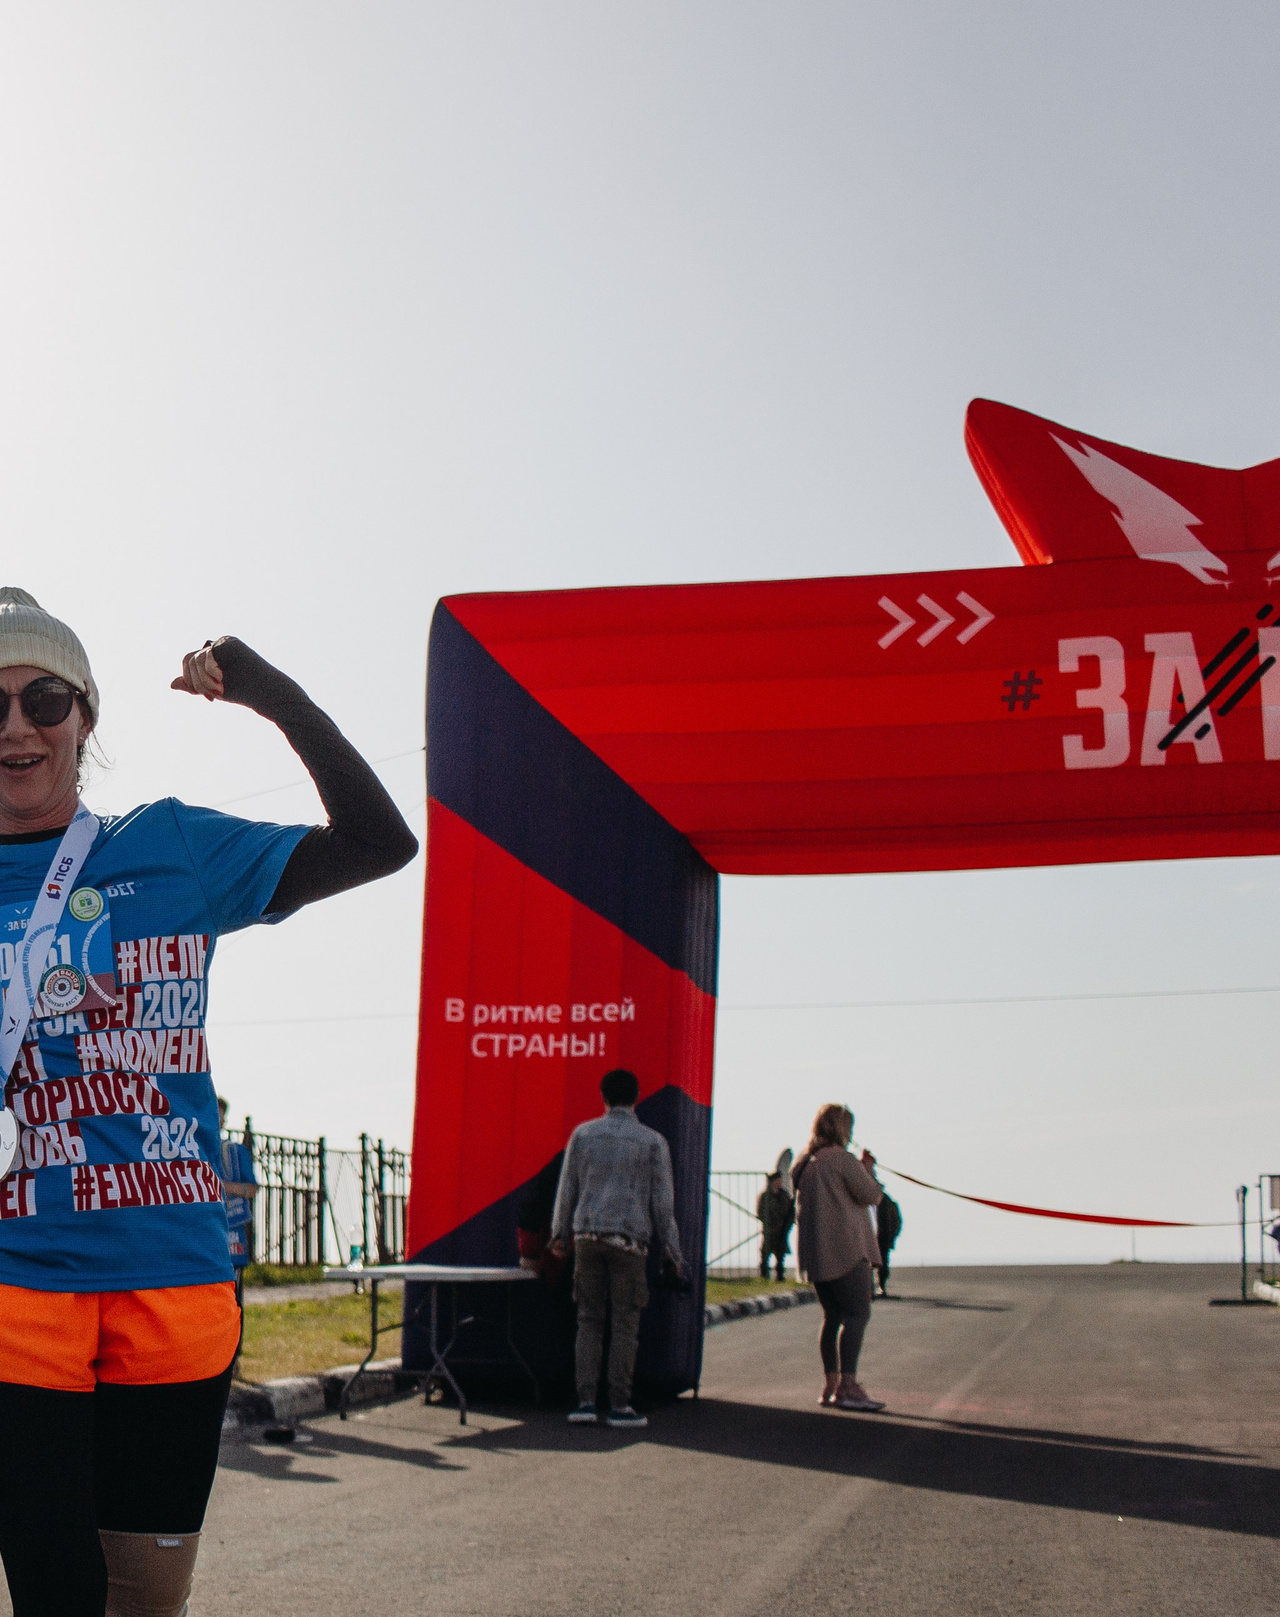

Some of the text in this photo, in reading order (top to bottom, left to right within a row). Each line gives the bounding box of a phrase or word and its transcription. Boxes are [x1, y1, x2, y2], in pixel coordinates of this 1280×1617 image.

[53, 856, 74, 883] ПСБ
[7, 918, 29, 932] ЗАБ
[445, 996, 636, 1027] В ритме всей
[470, 1032, 607, 1058] СТРАНЫ!
[5, 1071, 170, 1128] ГОРДОСТЬ
[141, 1115, 200, 1160] 2024
[71, 1160, 223, 1212] #ЕДИНСТВ
